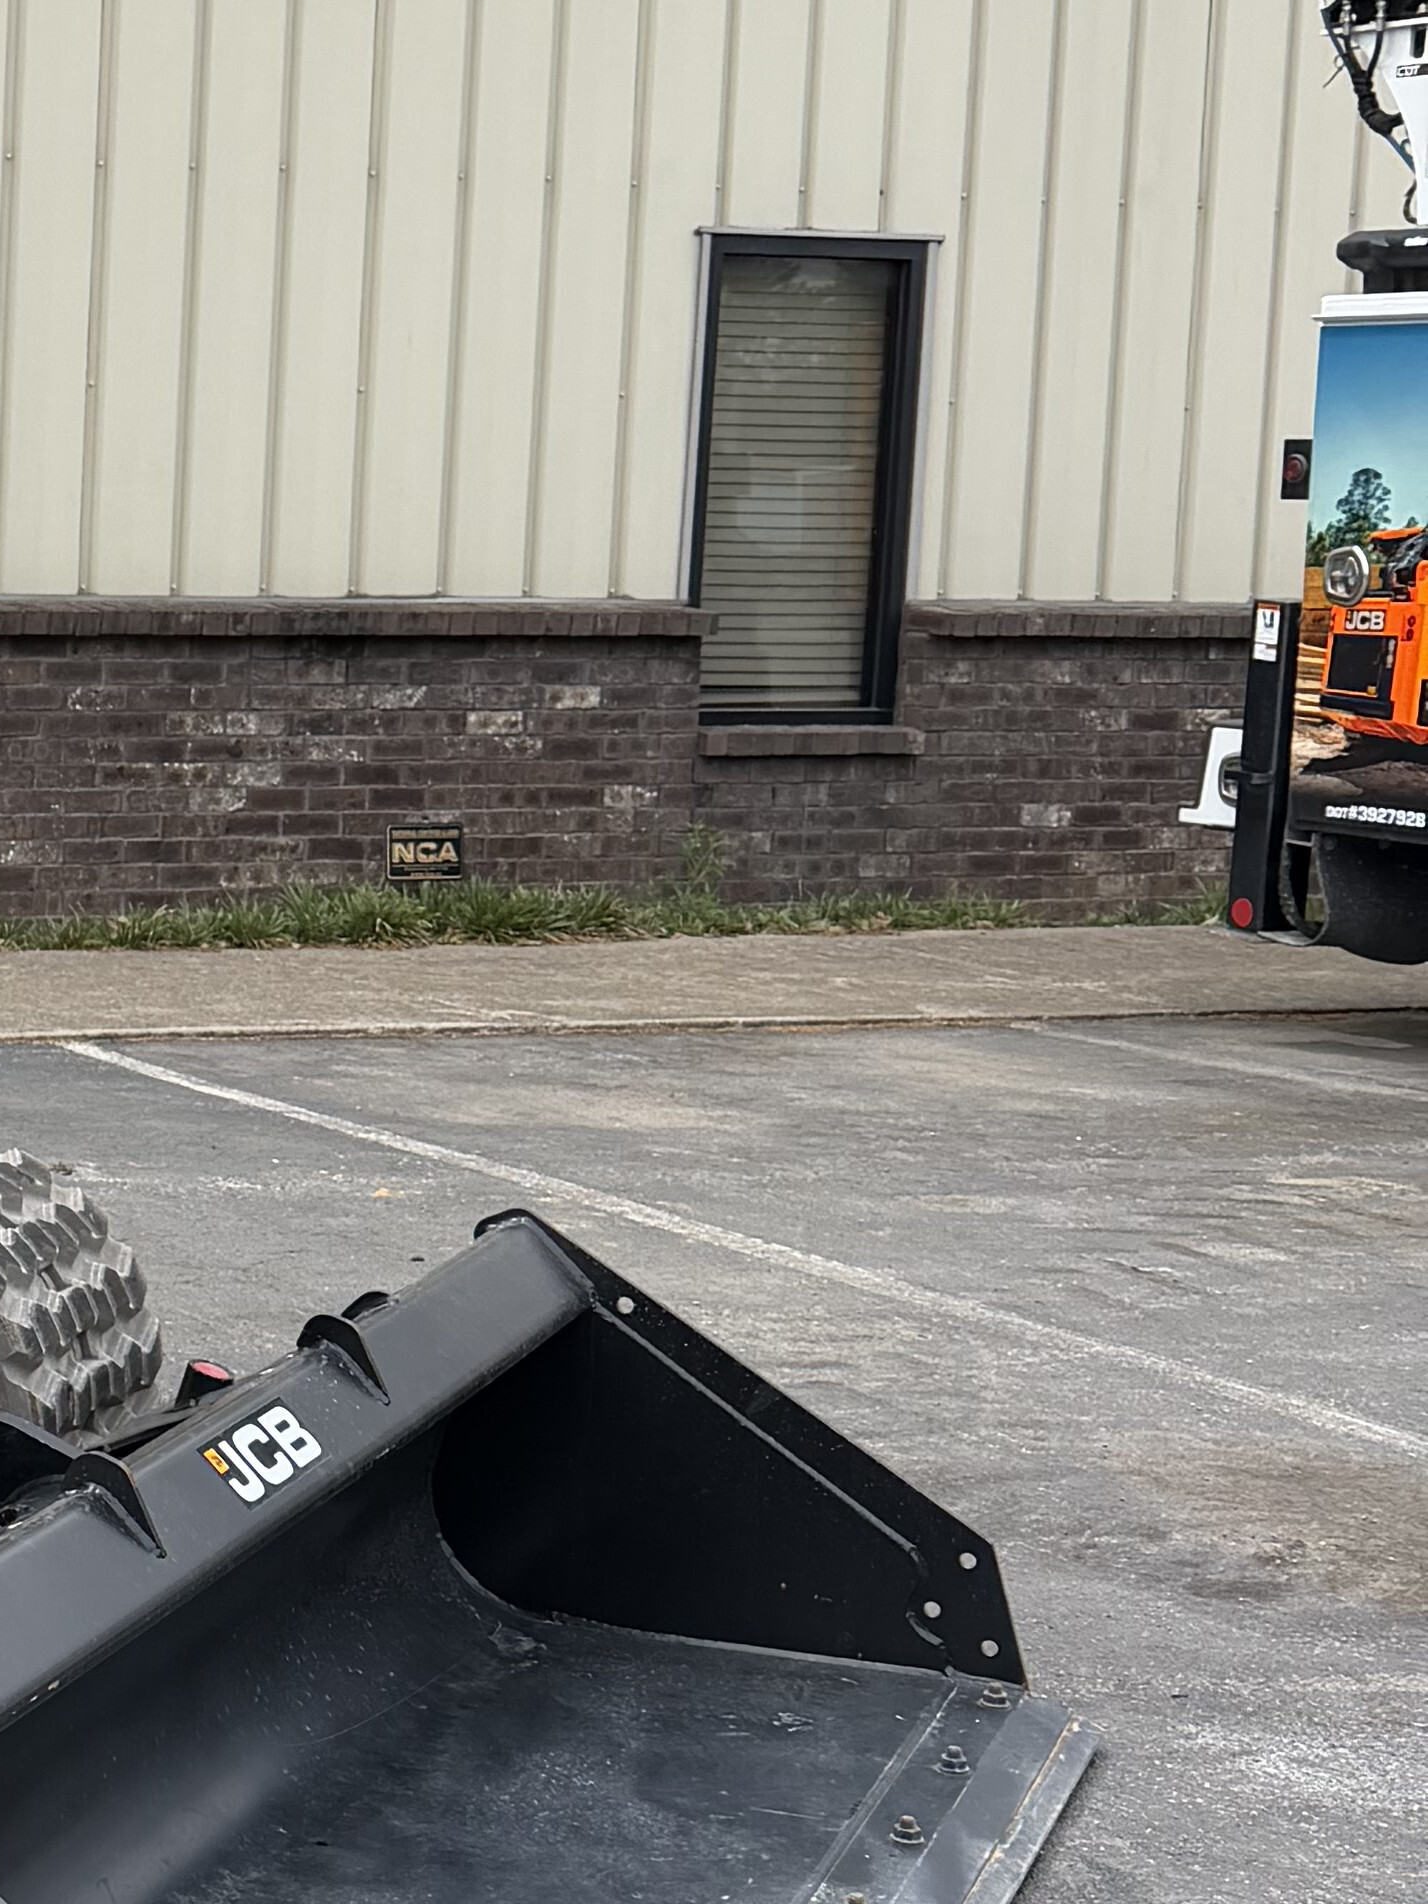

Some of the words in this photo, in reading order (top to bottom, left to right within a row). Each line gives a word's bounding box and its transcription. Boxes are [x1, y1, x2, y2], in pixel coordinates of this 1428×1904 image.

[1345, 610, 1385, 631] JCB
[391, 841, 459, 864] NCA
[218, 1405, 322, 1502] JCB
